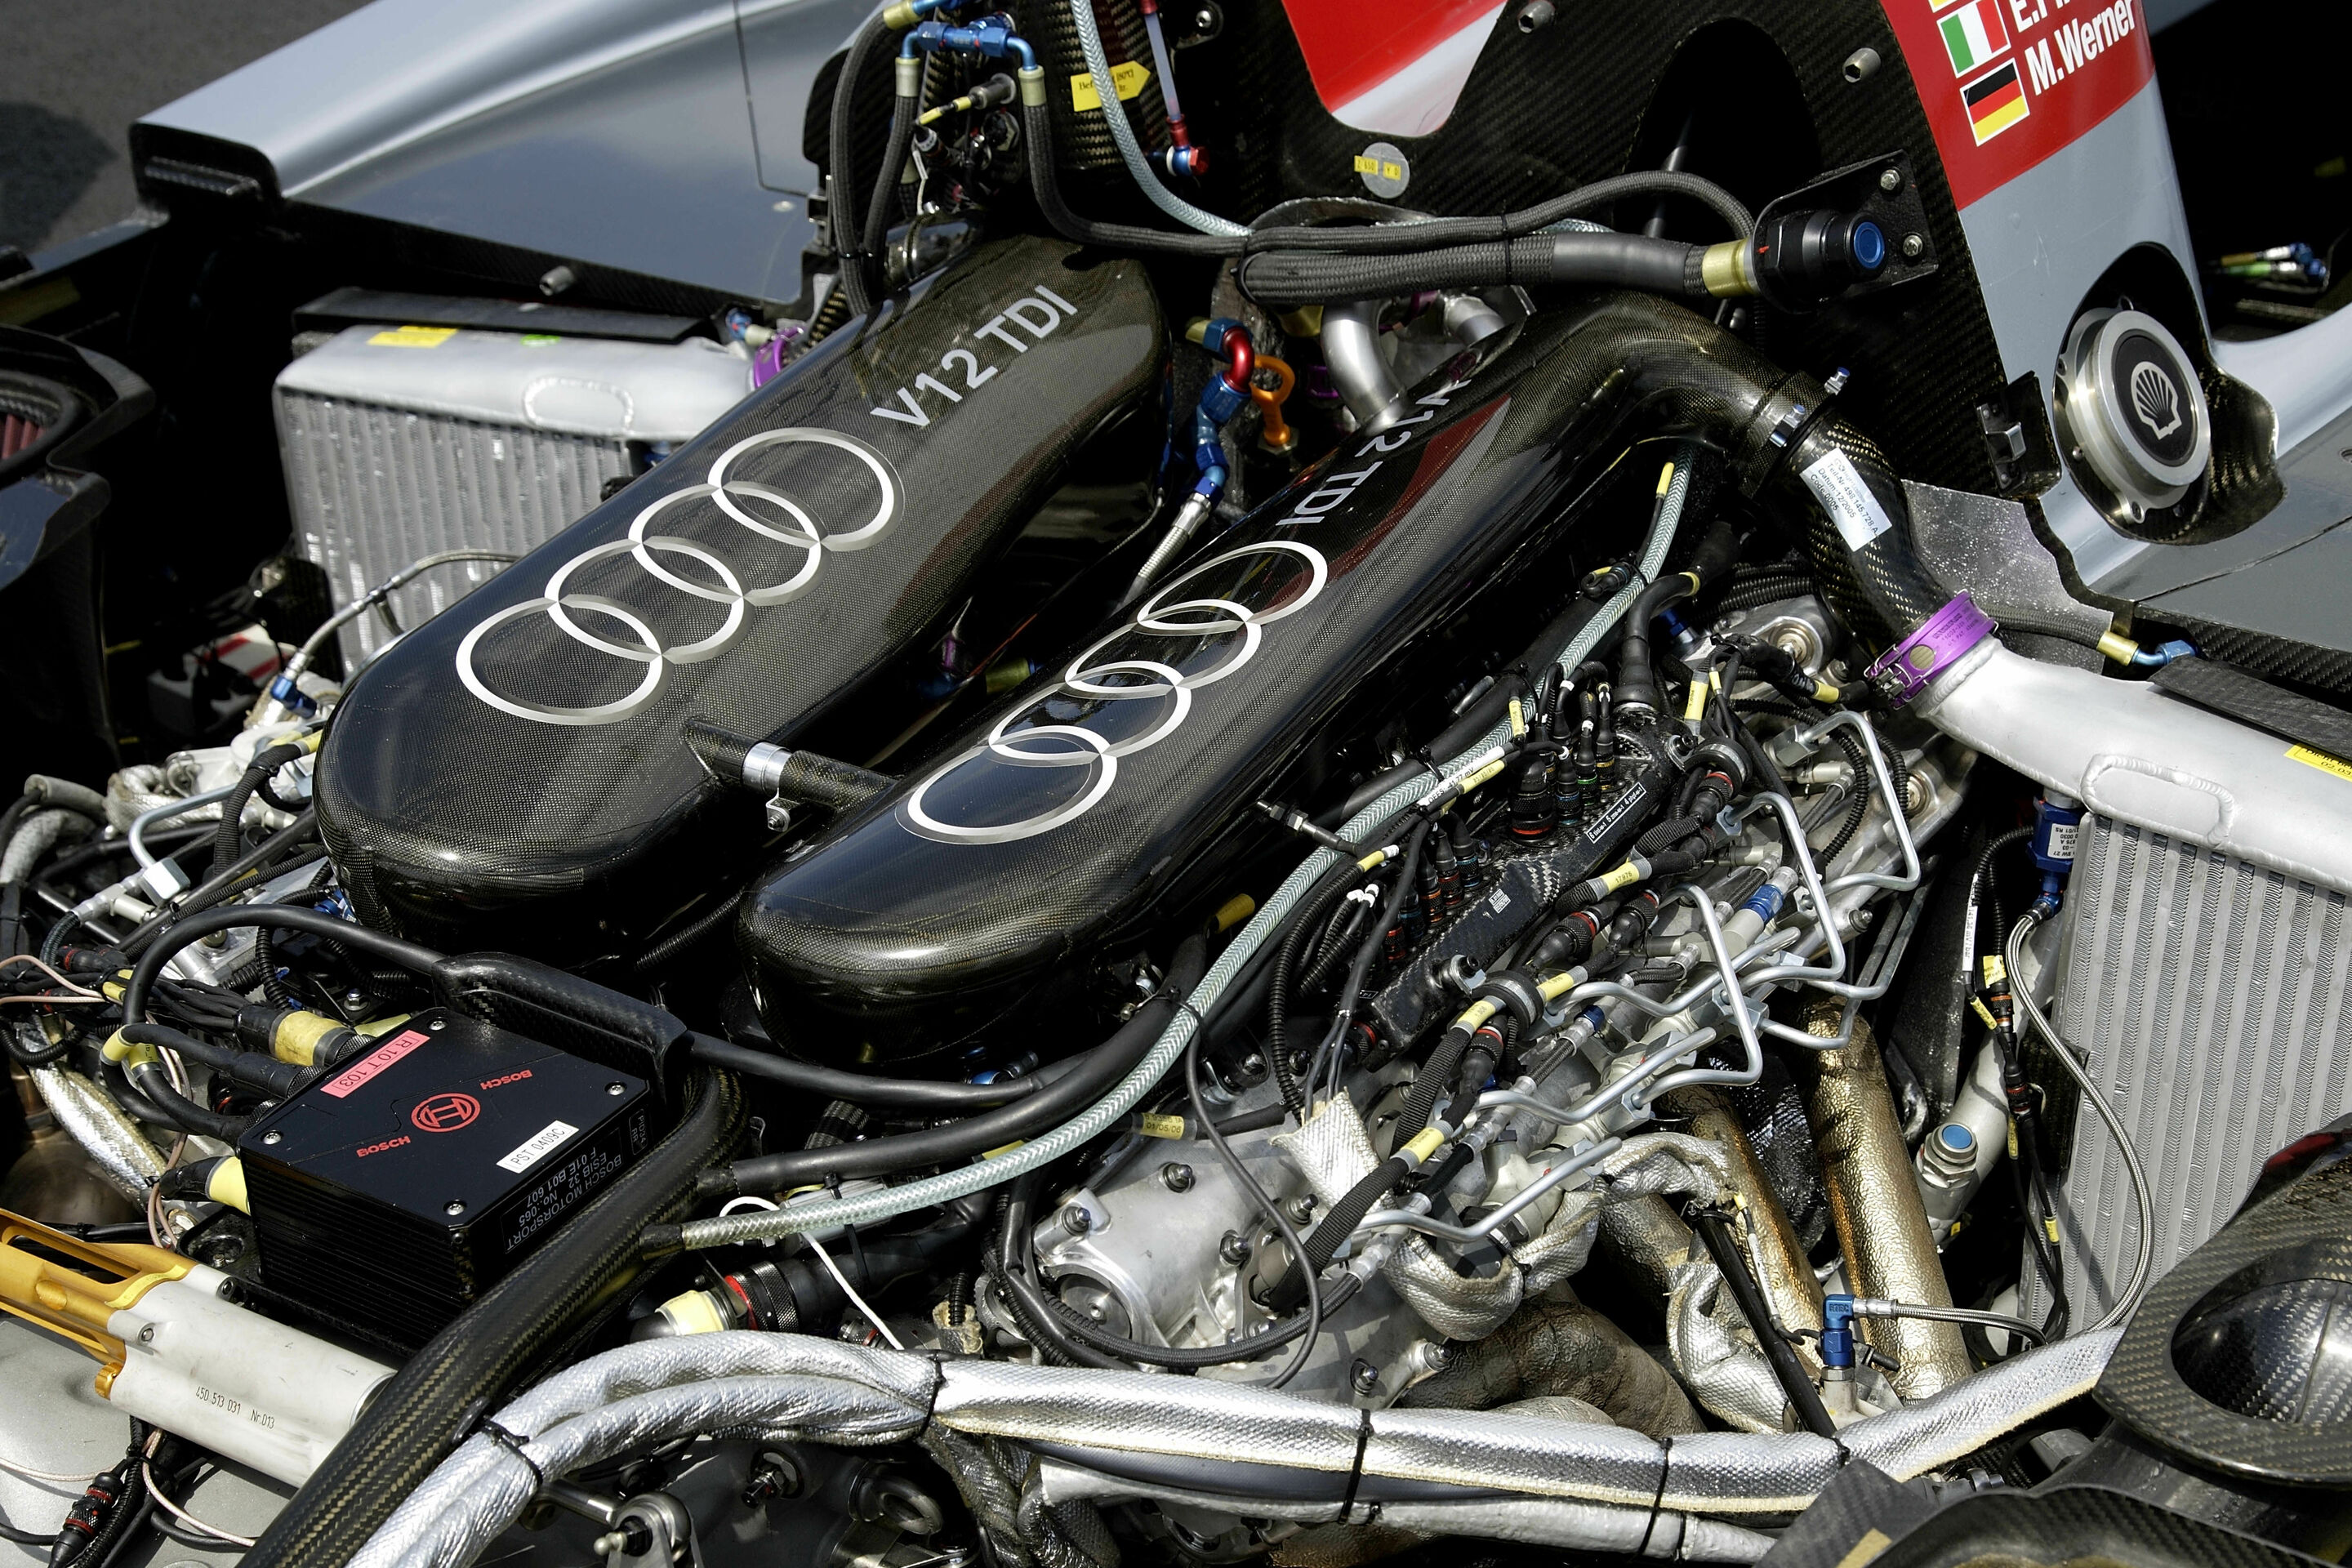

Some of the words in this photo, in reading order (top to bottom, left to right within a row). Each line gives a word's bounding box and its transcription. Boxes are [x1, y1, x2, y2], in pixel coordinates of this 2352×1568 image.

[2025, 0, 2136, 96] M.Werner
[870, 349, 999, 426] V12
[973, 285, 1078, 353] TDI
[1276, 461, 1383, 526] TDI
[1811, 474, 1839, 511] Code:0005
[395, 1039, 413, 1049] R
[339, 1070, 368, 1087] 103
[480, 1069, 533, 1090] BOSCH
[356, 1135, 411, 1157] BOSCH
[510, 1149, 534, 1165] PST
[531, 1128, 565, 1151] 0409C
[590, 1147, 597, 1158] F
[583, 1152, 607, 1174] ESIB
[585, 1154, 622, 1190] BOSCH
[548, 1172, 567, 1191] B01
[568, 1174, 580, 1188] 32
[527, 1187, 545, 1208] 607
[507, 1187, 582, 1251] MOTORSPORT
[196, 1386, 209, 1401] 450
[212, 1392, 225, 1408] 513
[227, 1399, 241, 1415] 031
[250, 1409, 275, 1429] Nr.013
